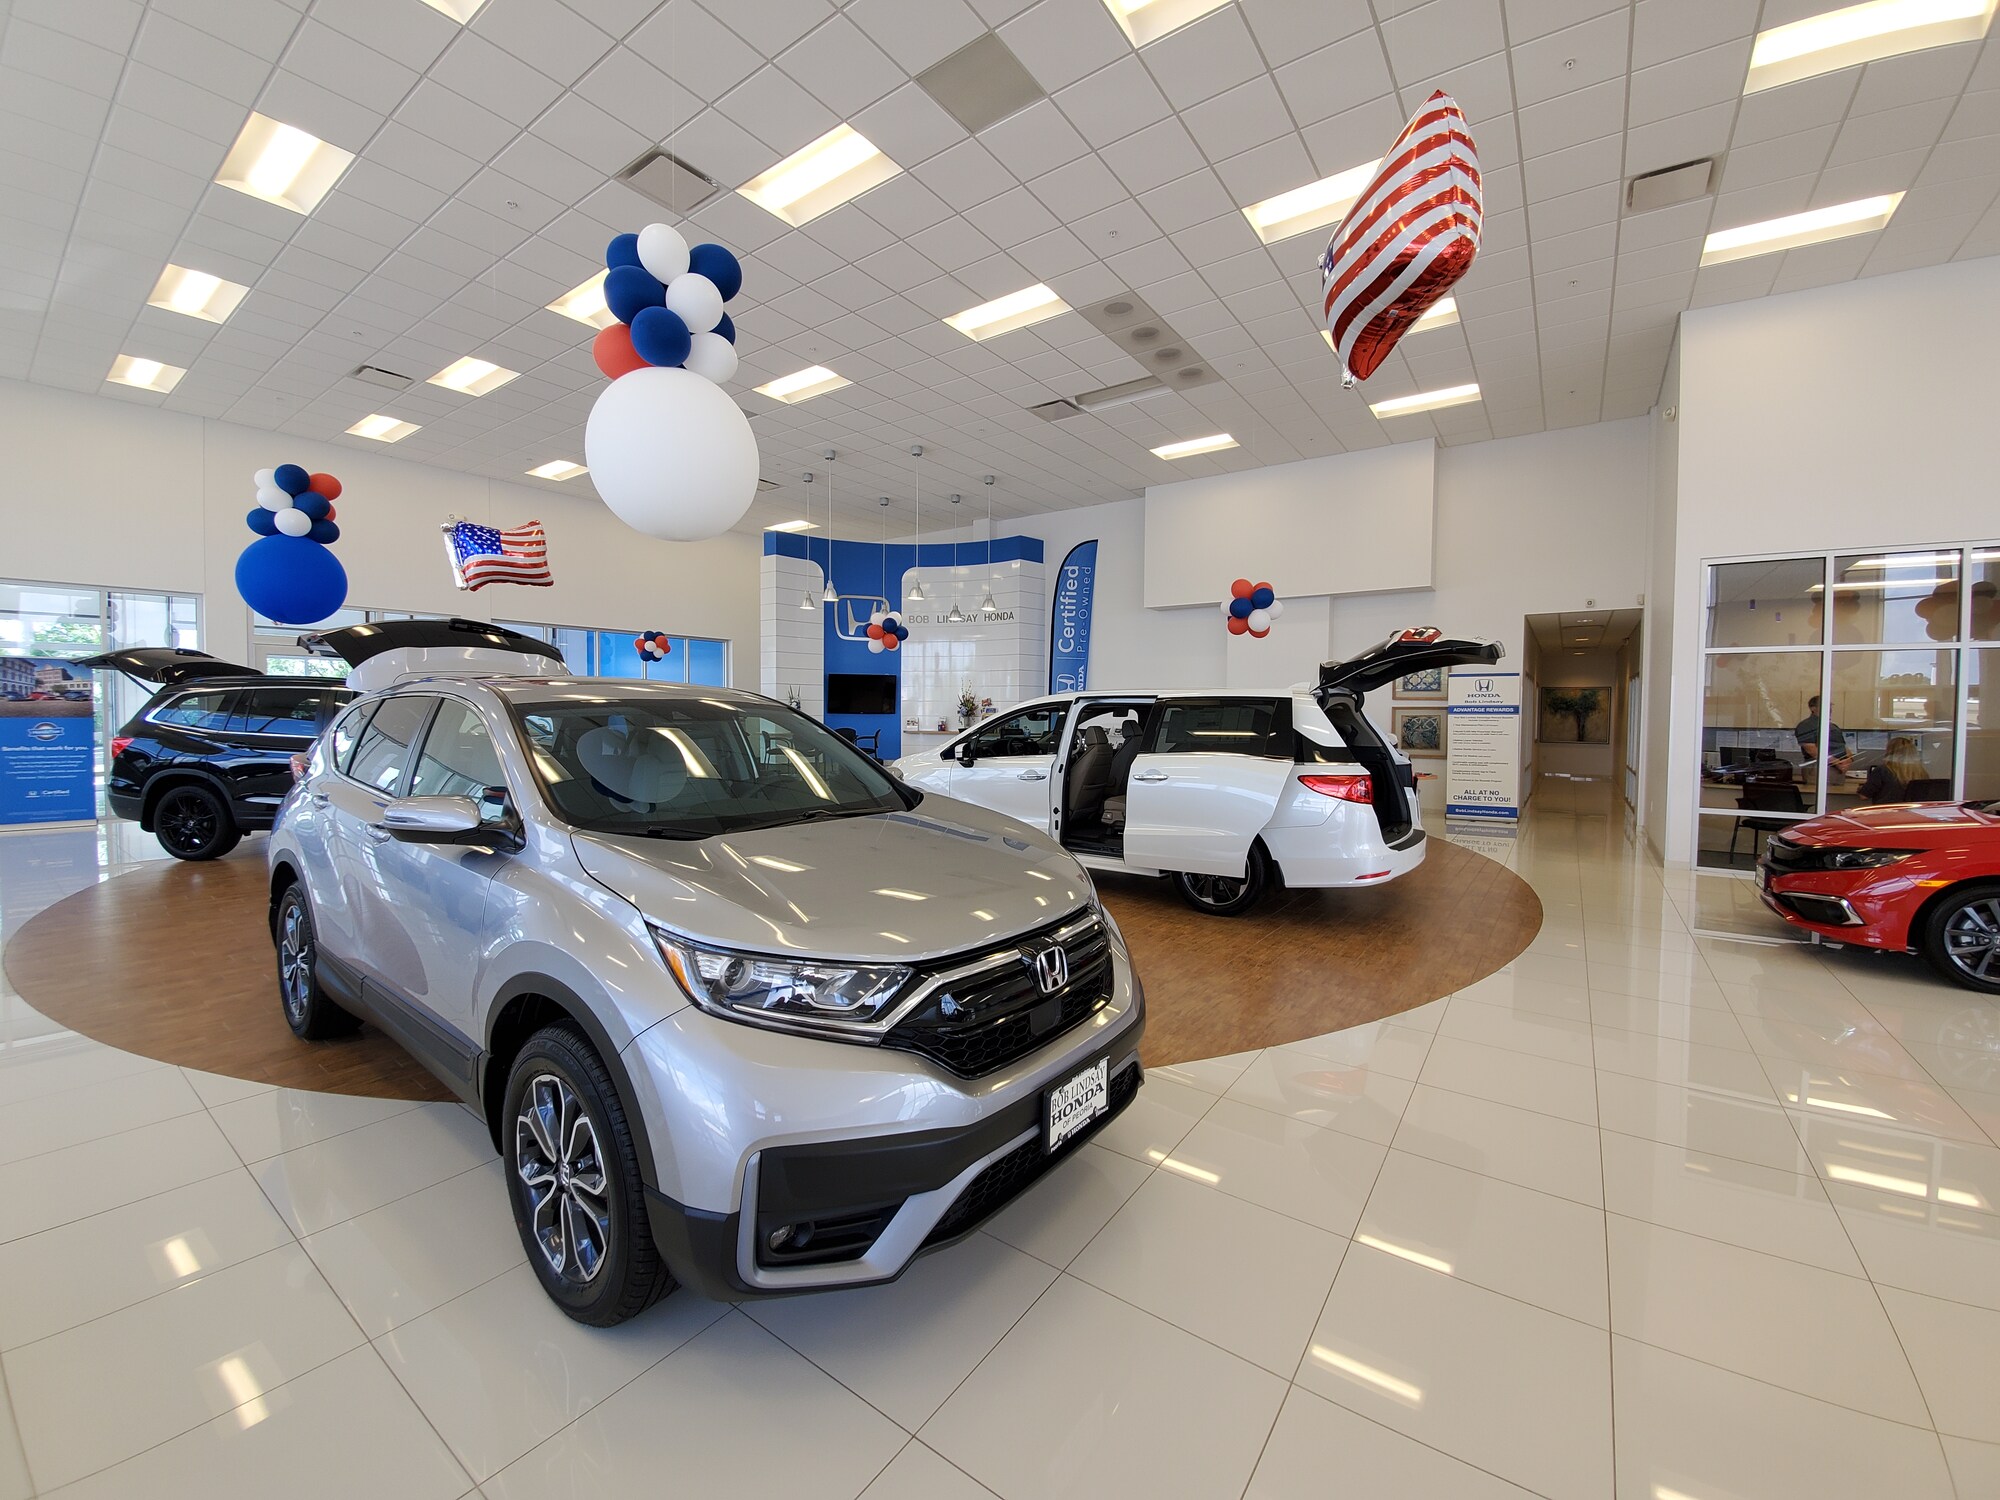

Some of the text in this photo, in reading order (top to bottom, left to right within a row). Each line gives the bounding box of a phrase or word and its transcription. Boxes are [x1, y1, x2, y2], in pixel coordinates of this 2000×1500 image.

[908, 611, 1015, 624] BOB LINSAY HONDA
[1058, 565, 1079, 653] Certified
[1077, 566, 1092, 653] Pre-Owned
[1077, 664, 1085, 692] NDA
[1051, 1089, 1070, 1113] BOB
[1070, 1066, 1106, 1100] LINDSAY
[1051, 1082, 1105, 1128] HONDA
[1062, 1118, 1071, 1129] OF
[1071, 1102, 1094, 1122] PEORIA
[1071, 1118, 1091, 1135] HONDA
